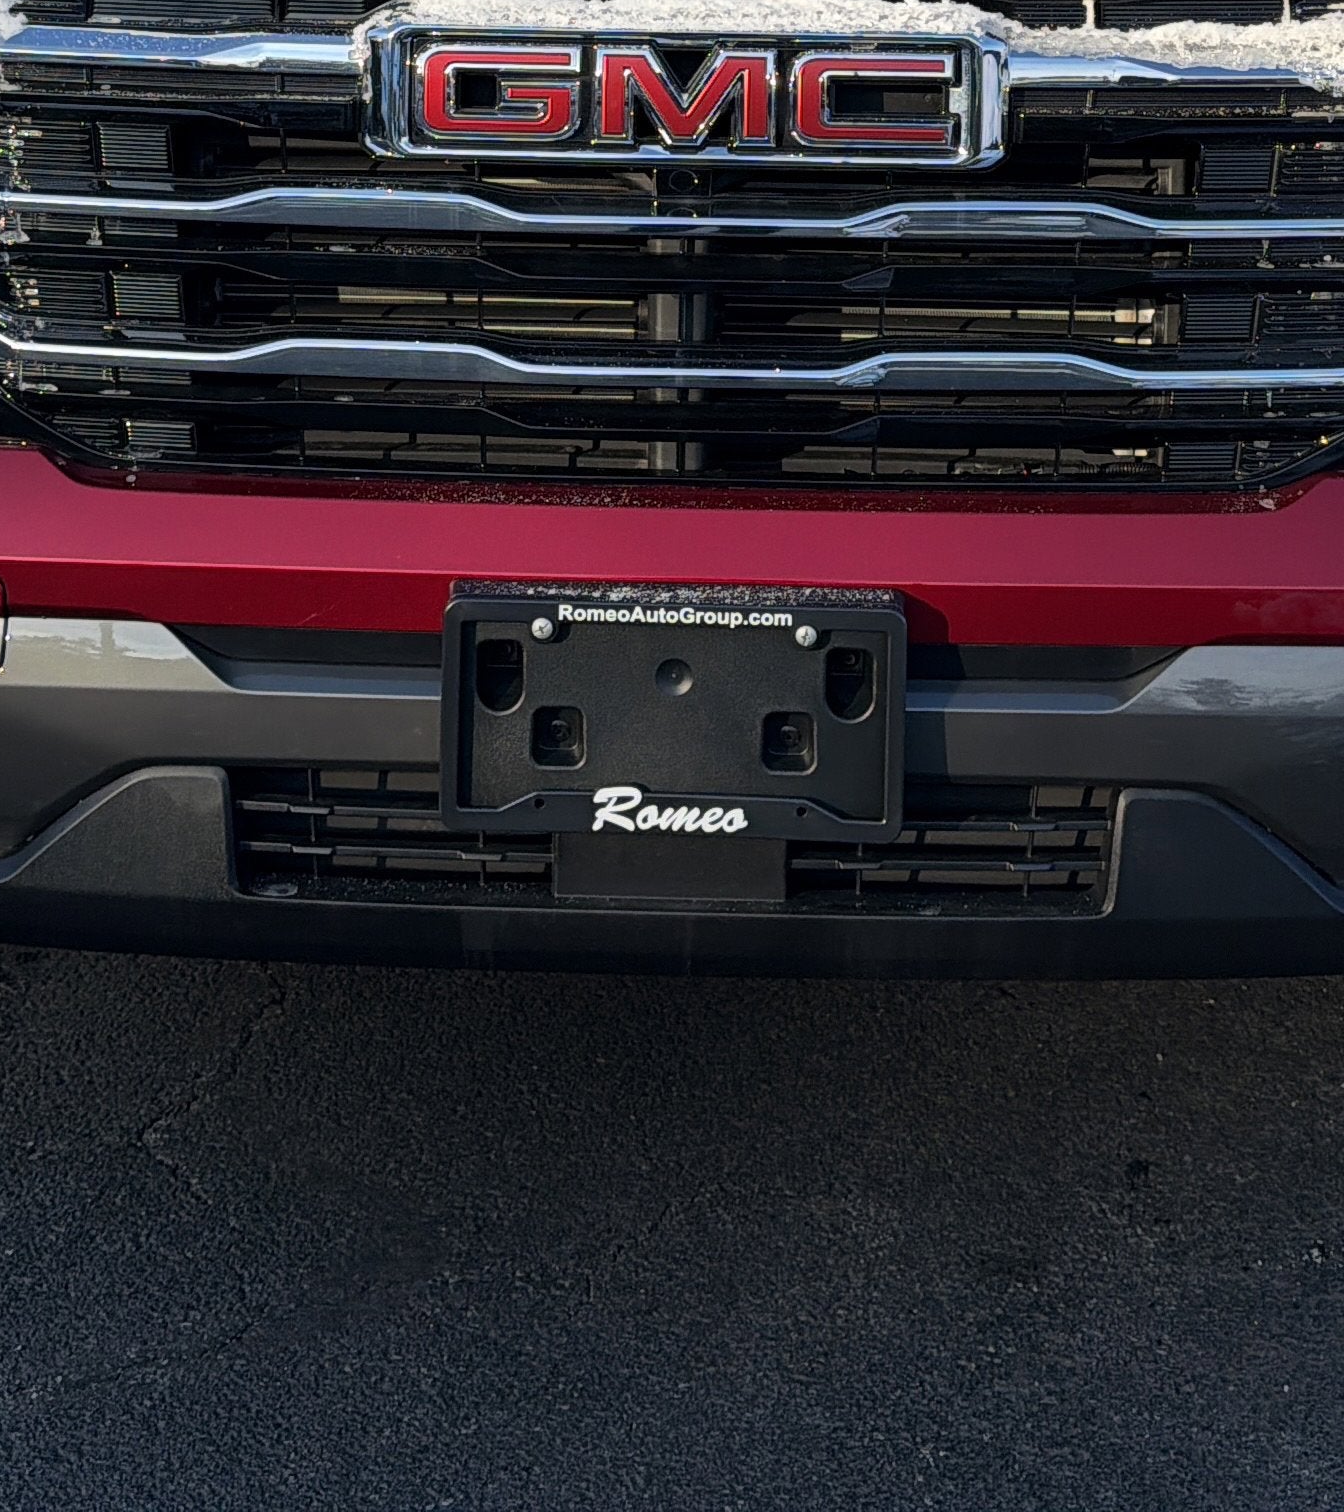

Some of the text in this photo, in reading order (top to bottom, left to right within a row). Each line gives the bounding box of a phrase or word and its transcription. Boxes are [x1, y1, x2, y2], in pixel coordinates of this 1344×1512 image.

[415, 43, 958, 147] GMC
[557, 603, 794, 629] RomeoAutoGroup.com
[591, 785, 750, 834] Romeo
